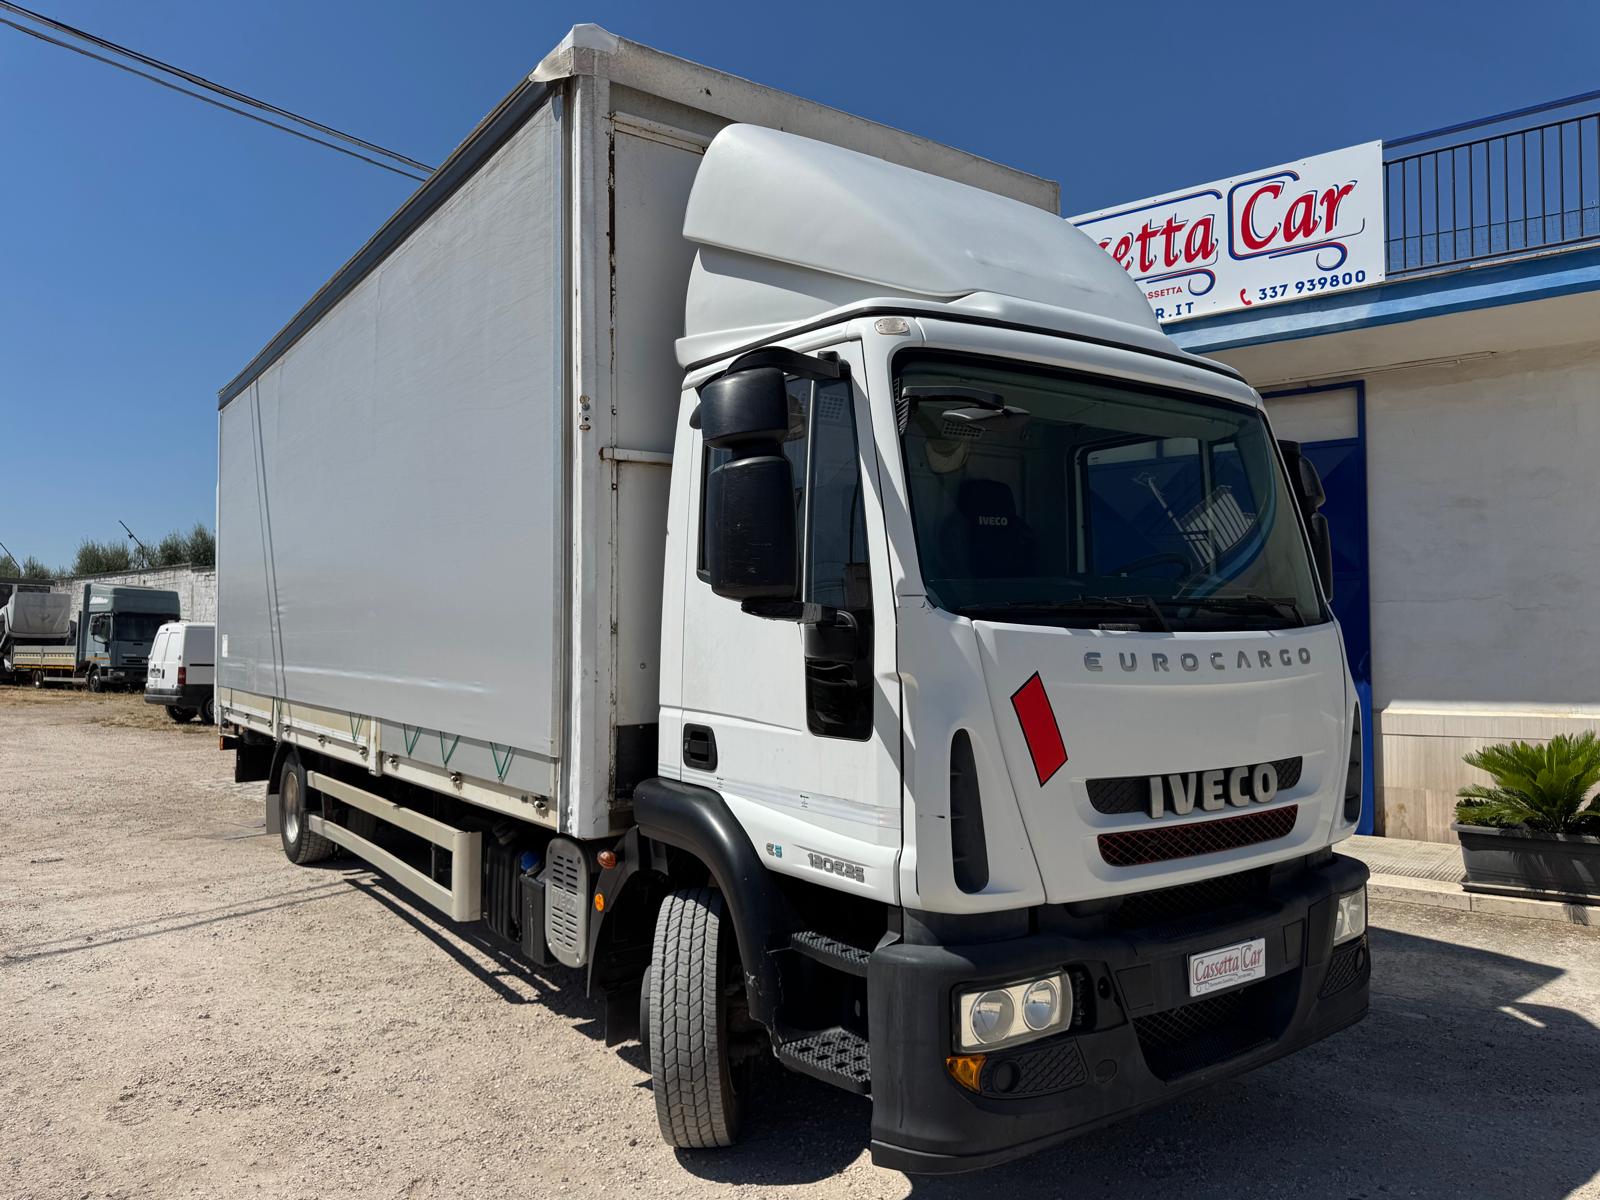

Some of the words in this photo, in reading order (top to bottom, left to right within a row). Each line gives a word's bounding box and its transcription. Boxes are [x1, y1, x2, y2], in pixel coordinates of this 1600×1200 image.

[1241, 180, 1358, 250] Car
[1143, 286, 1183, 299] SSETTA
[1258, 284, 1288, 300] 337
[1295, 270, 1366, 294] 939800
[979, 516, 1008, 526] IVECO
[1083, 647, 1311, 672] EUROCARGO
[1149, 762, 1278, 819] IVECO
[808, 853, 865, 883] 120E25
[1195, 955, 1240, 982] Cassetta
[1243, 947, 1263, 968] Car
